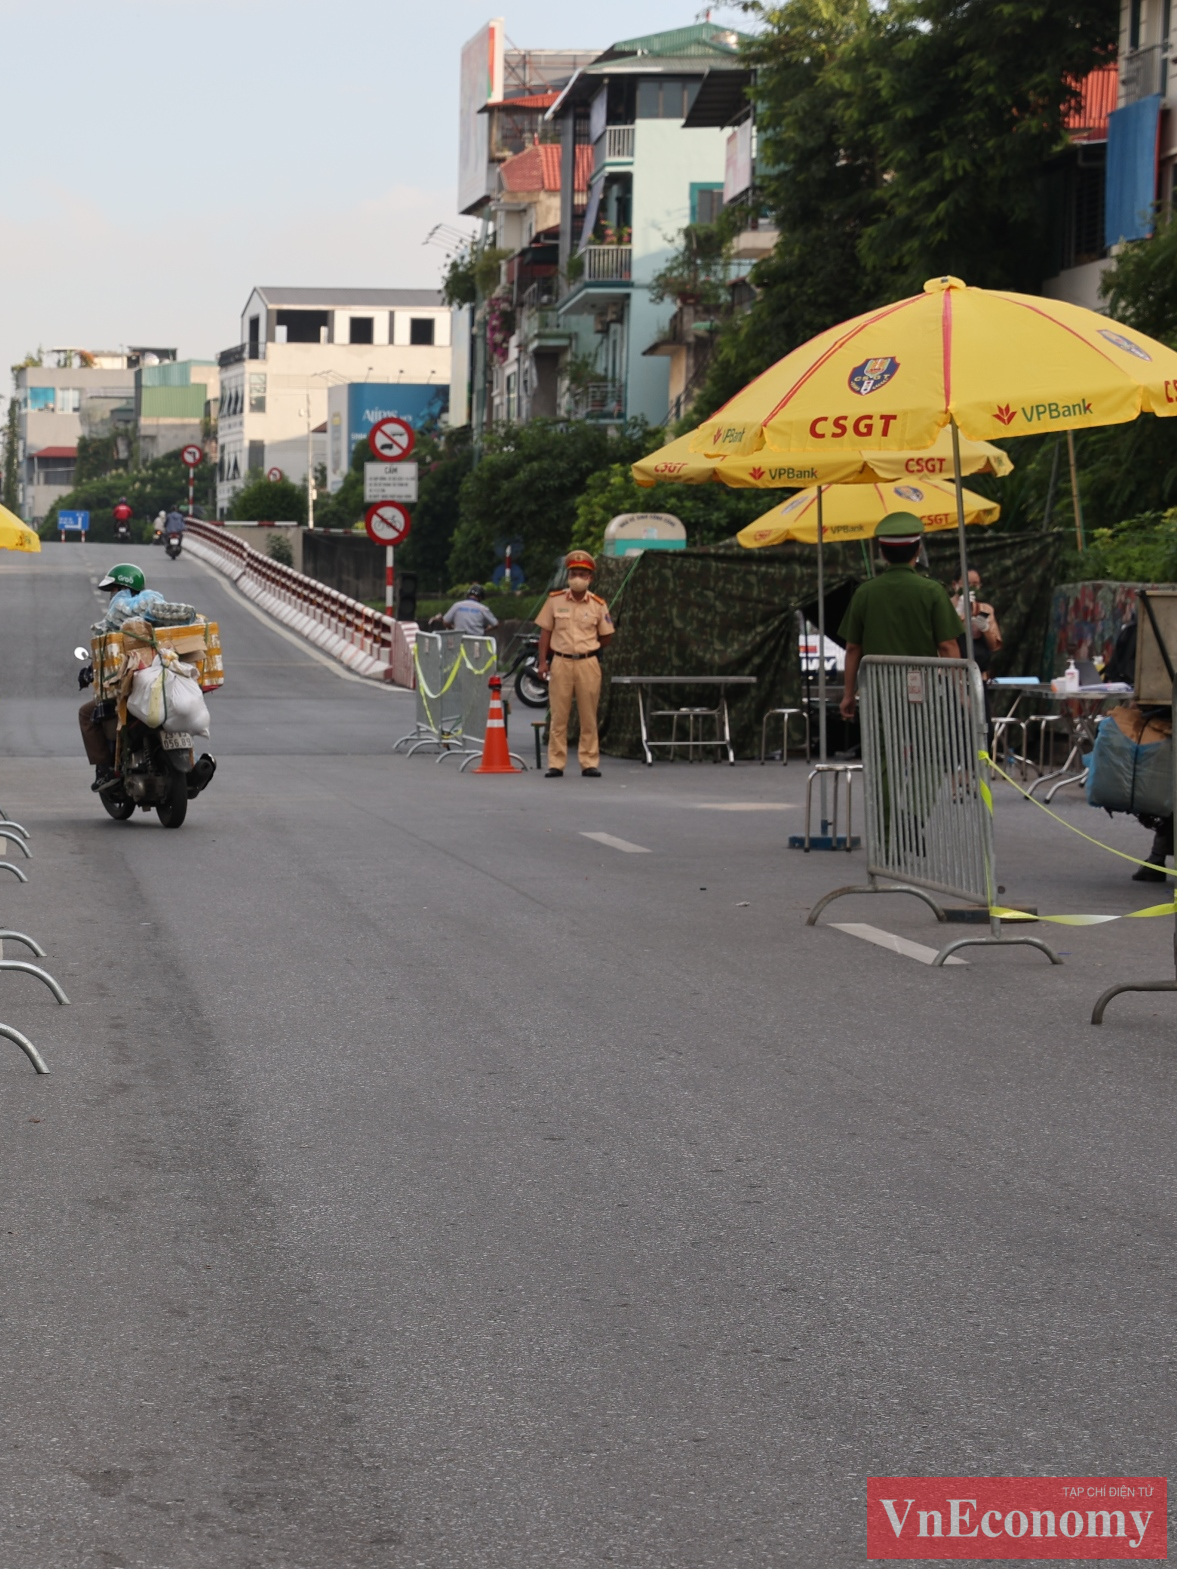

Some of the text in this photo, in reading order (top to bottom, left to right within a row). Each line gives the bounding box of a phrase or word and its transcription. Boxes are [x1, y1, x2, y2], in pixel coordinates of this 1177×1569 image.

[1022, 398, 1093, 422] VPBank
[809, 414, 898, 439] CSGT
[769, 466, 818, 481] VPBank
[905, 457, 946, 474] CSGT
[830, 523, 864, 534] VPBank
[117, 574, 134, 584] Grab
